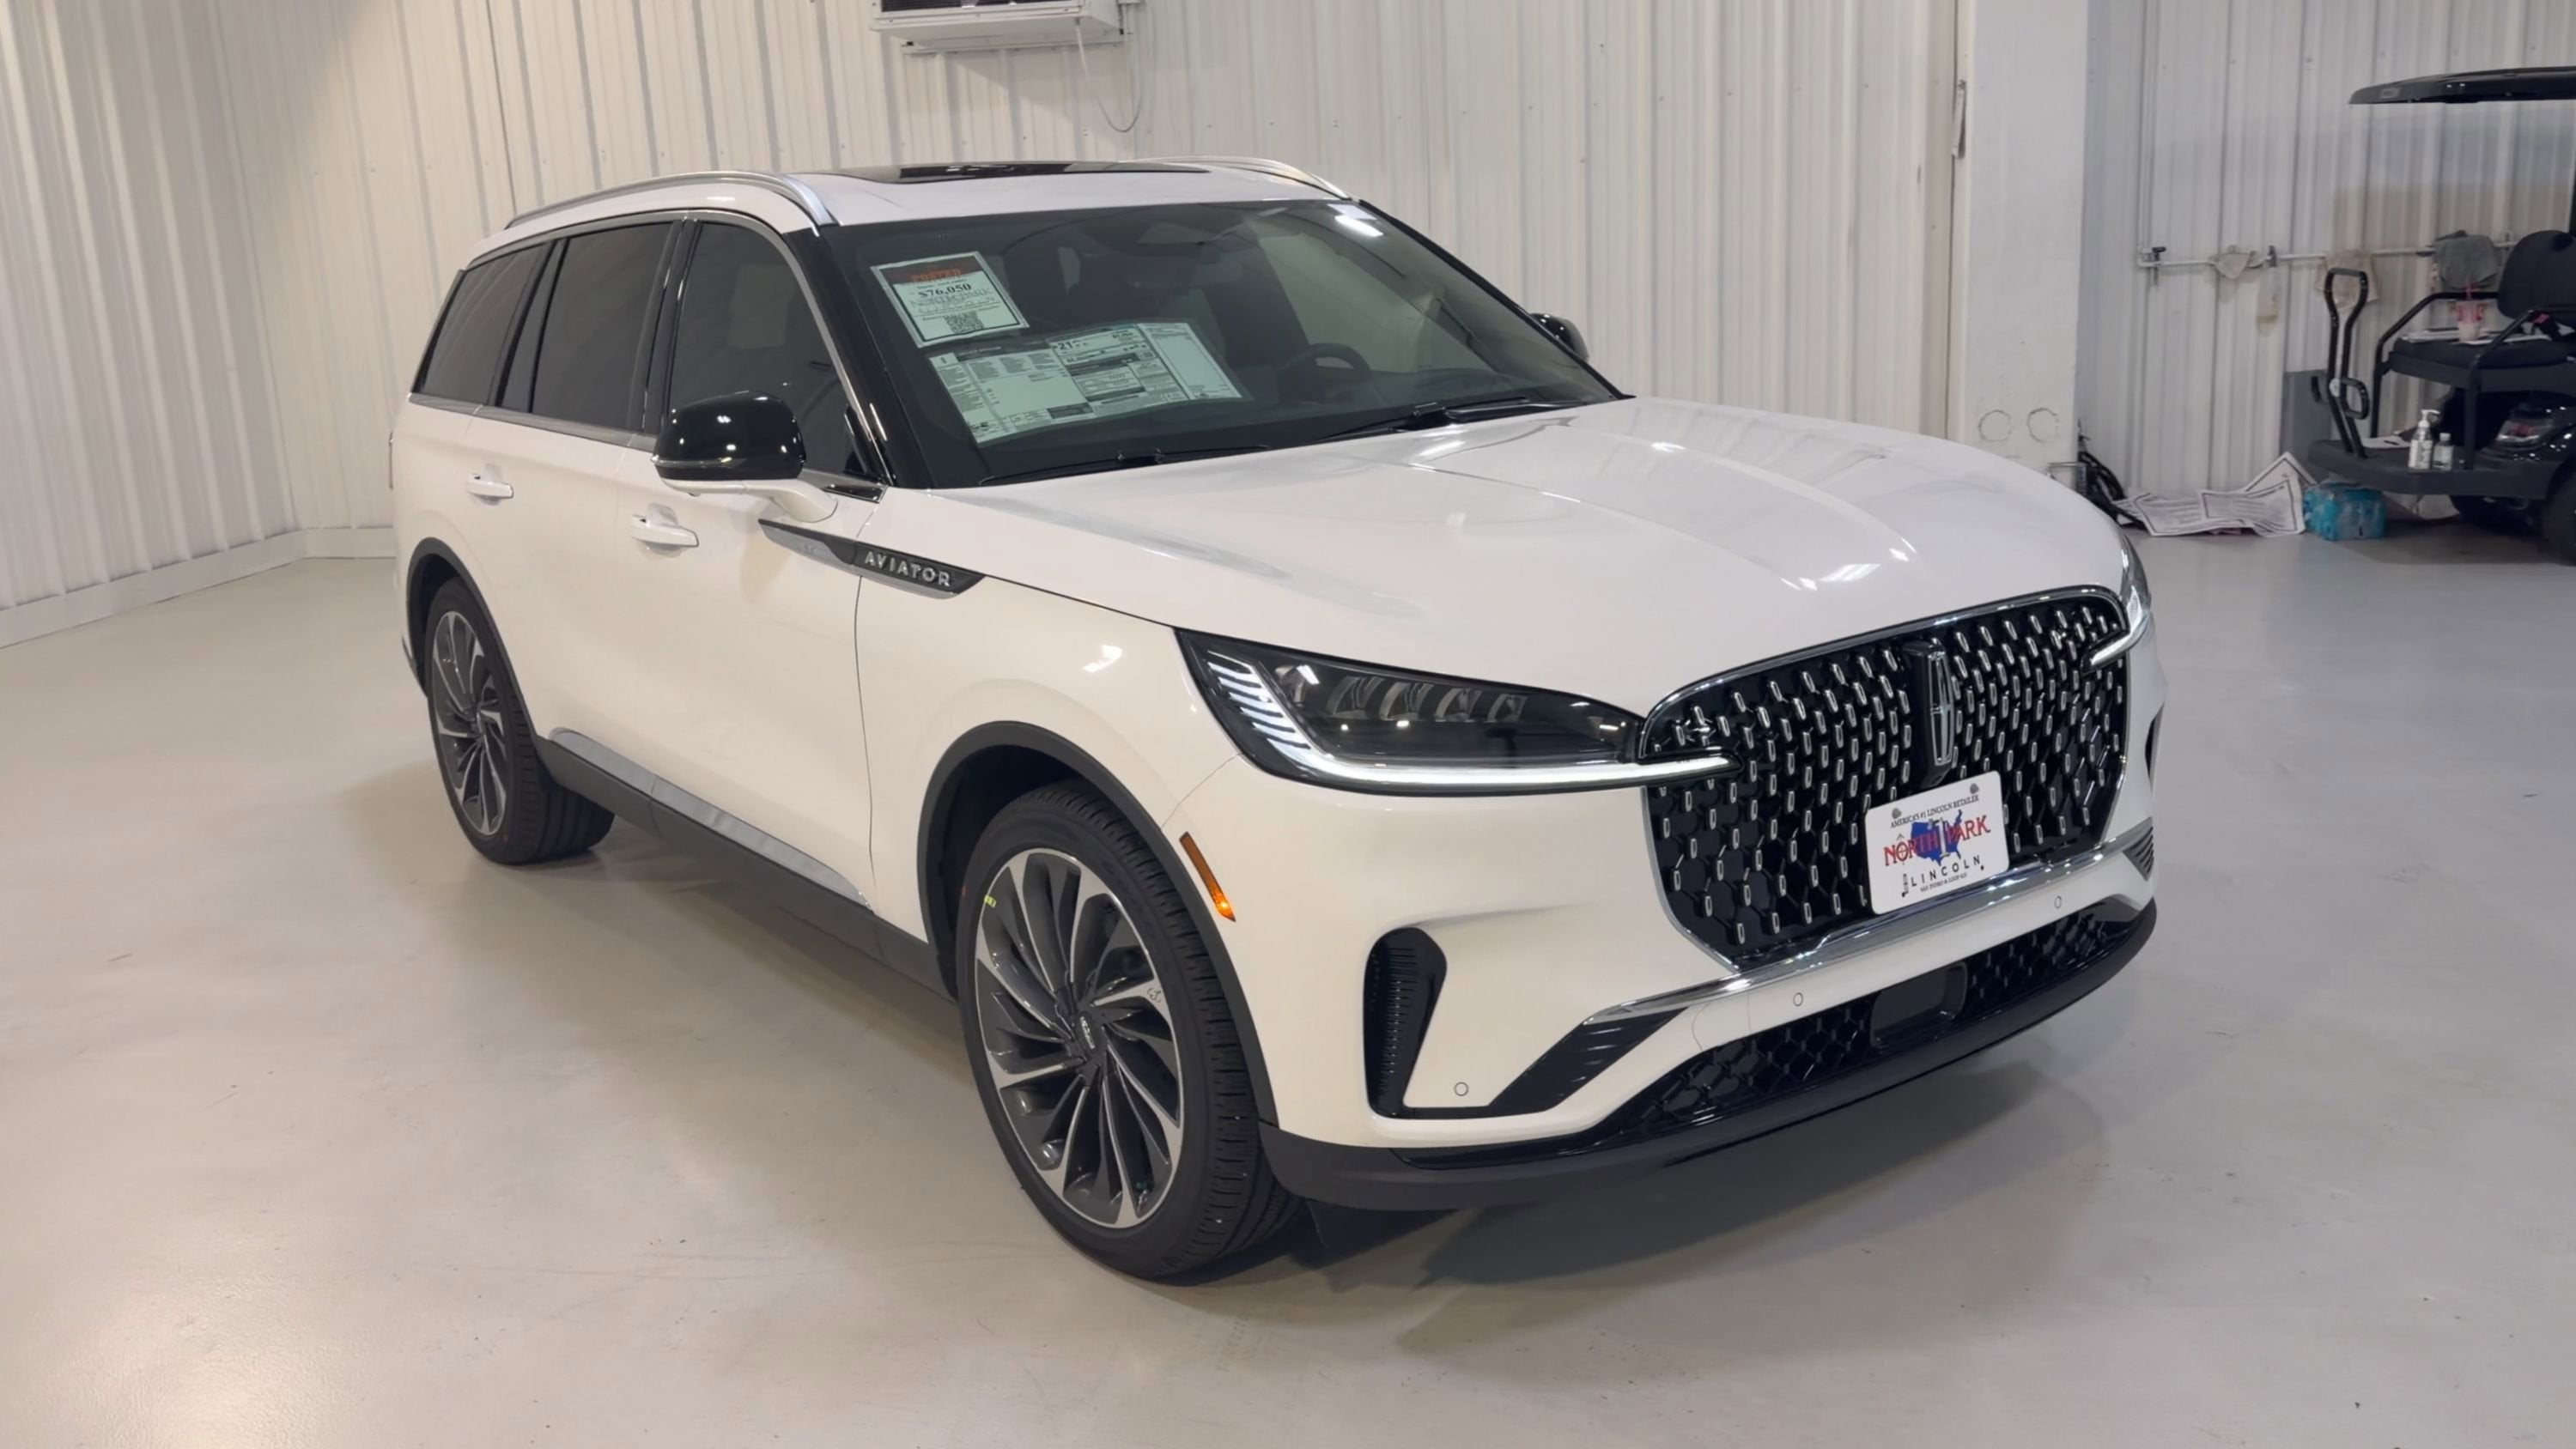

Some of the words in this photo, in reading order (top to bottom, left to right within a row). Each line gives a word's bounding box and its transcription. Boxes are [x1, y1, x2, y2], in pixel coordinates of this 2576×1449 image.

[918, 282, 972, 299] $76,050
[865, 551, 951, 587] AVIATOR
[1927, 803, 1953, 816] LINCOLN
[1953, 795, 1979, 809] RETAILER
[1883, 831, 1938, 866] NORTH
[1948, 815, 1991, 845] PARK
[1911, 855, 1981, 888] LINCOLN
